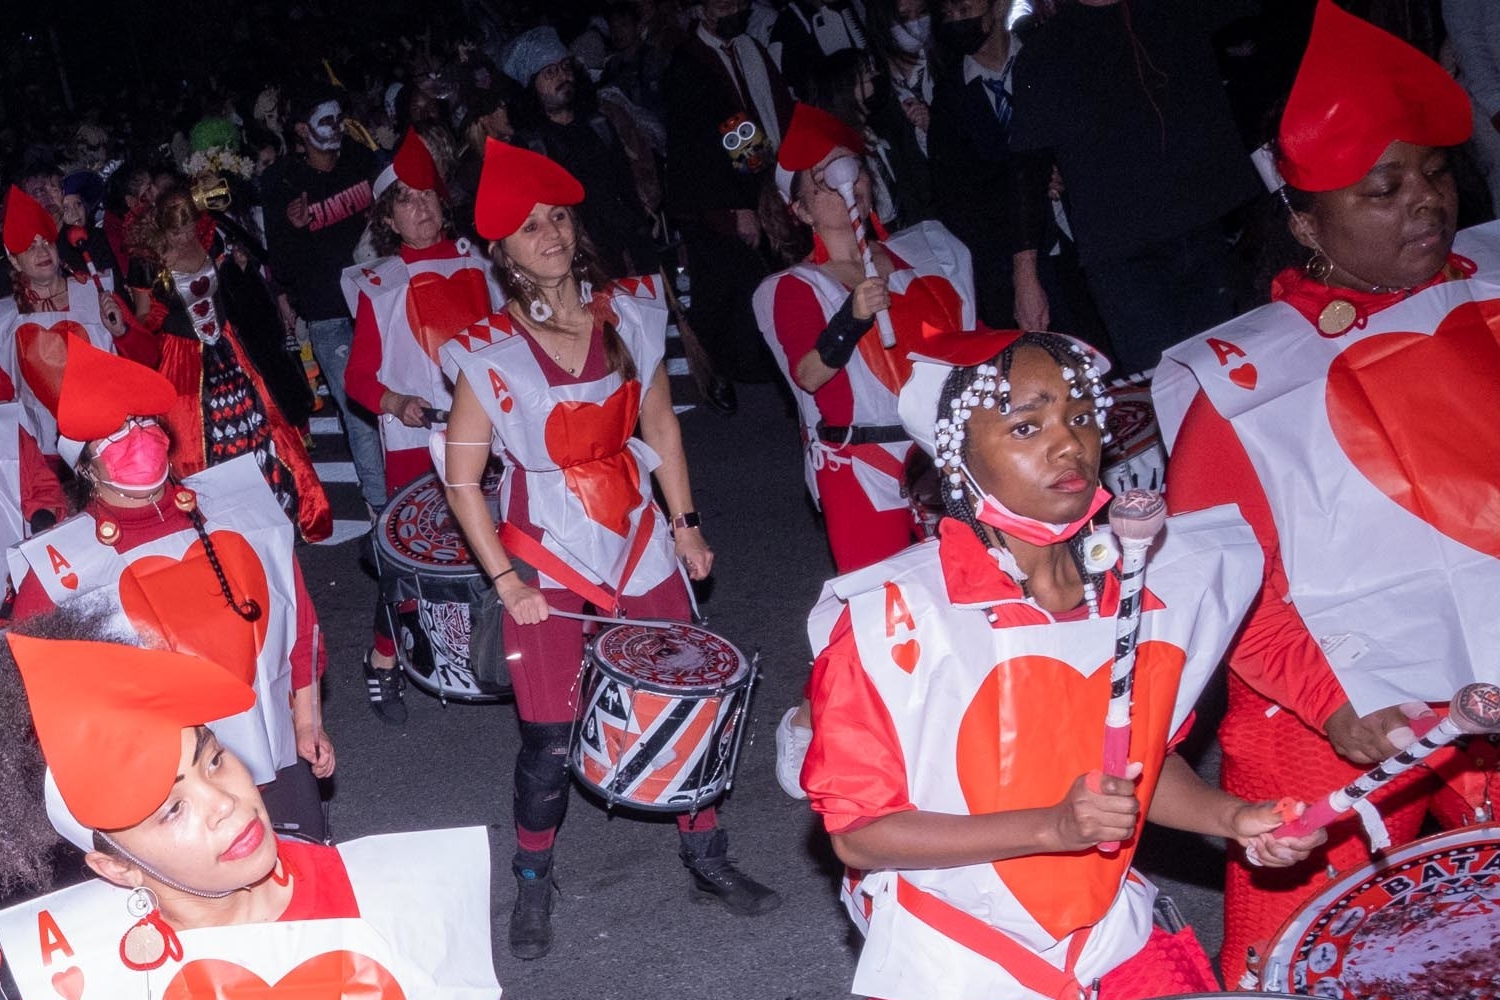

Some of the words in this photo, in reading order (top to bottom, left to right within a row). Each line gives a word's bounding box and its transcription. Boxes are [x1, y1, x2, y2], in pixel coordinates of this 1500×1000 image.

[1205, 337, 1247, 366] A
[487, 367, 509, 399] A
[46, 544, 71, 575] A
[884, 580, 916, 638] A
[38, 909, 76, 967] A
